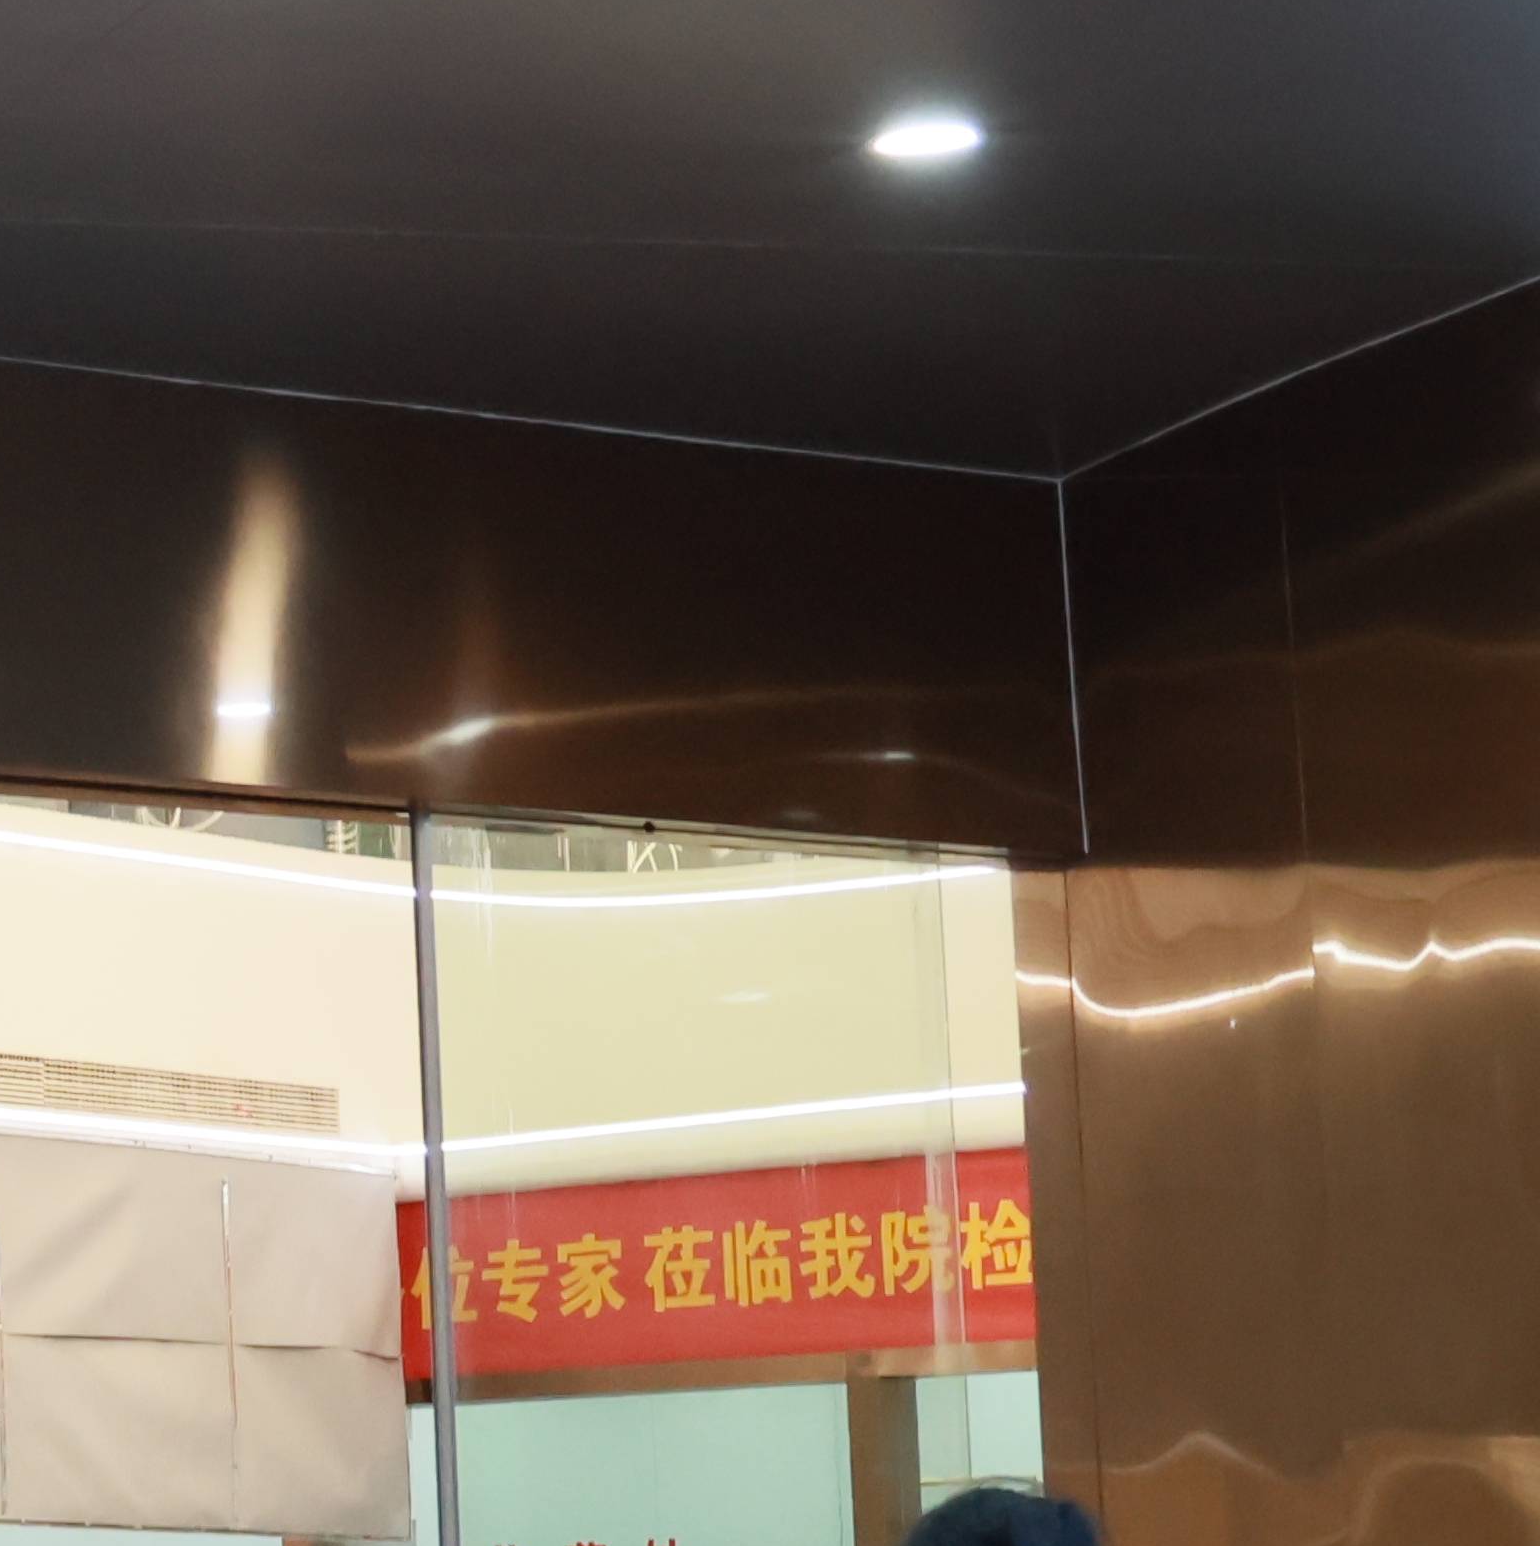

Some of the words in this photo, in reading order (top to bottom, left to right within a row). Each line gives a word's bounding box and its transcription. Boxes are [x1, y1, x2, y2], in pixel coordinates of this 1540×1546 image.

[402, 1198, 1032, 1330] 位专家莅临我院检
